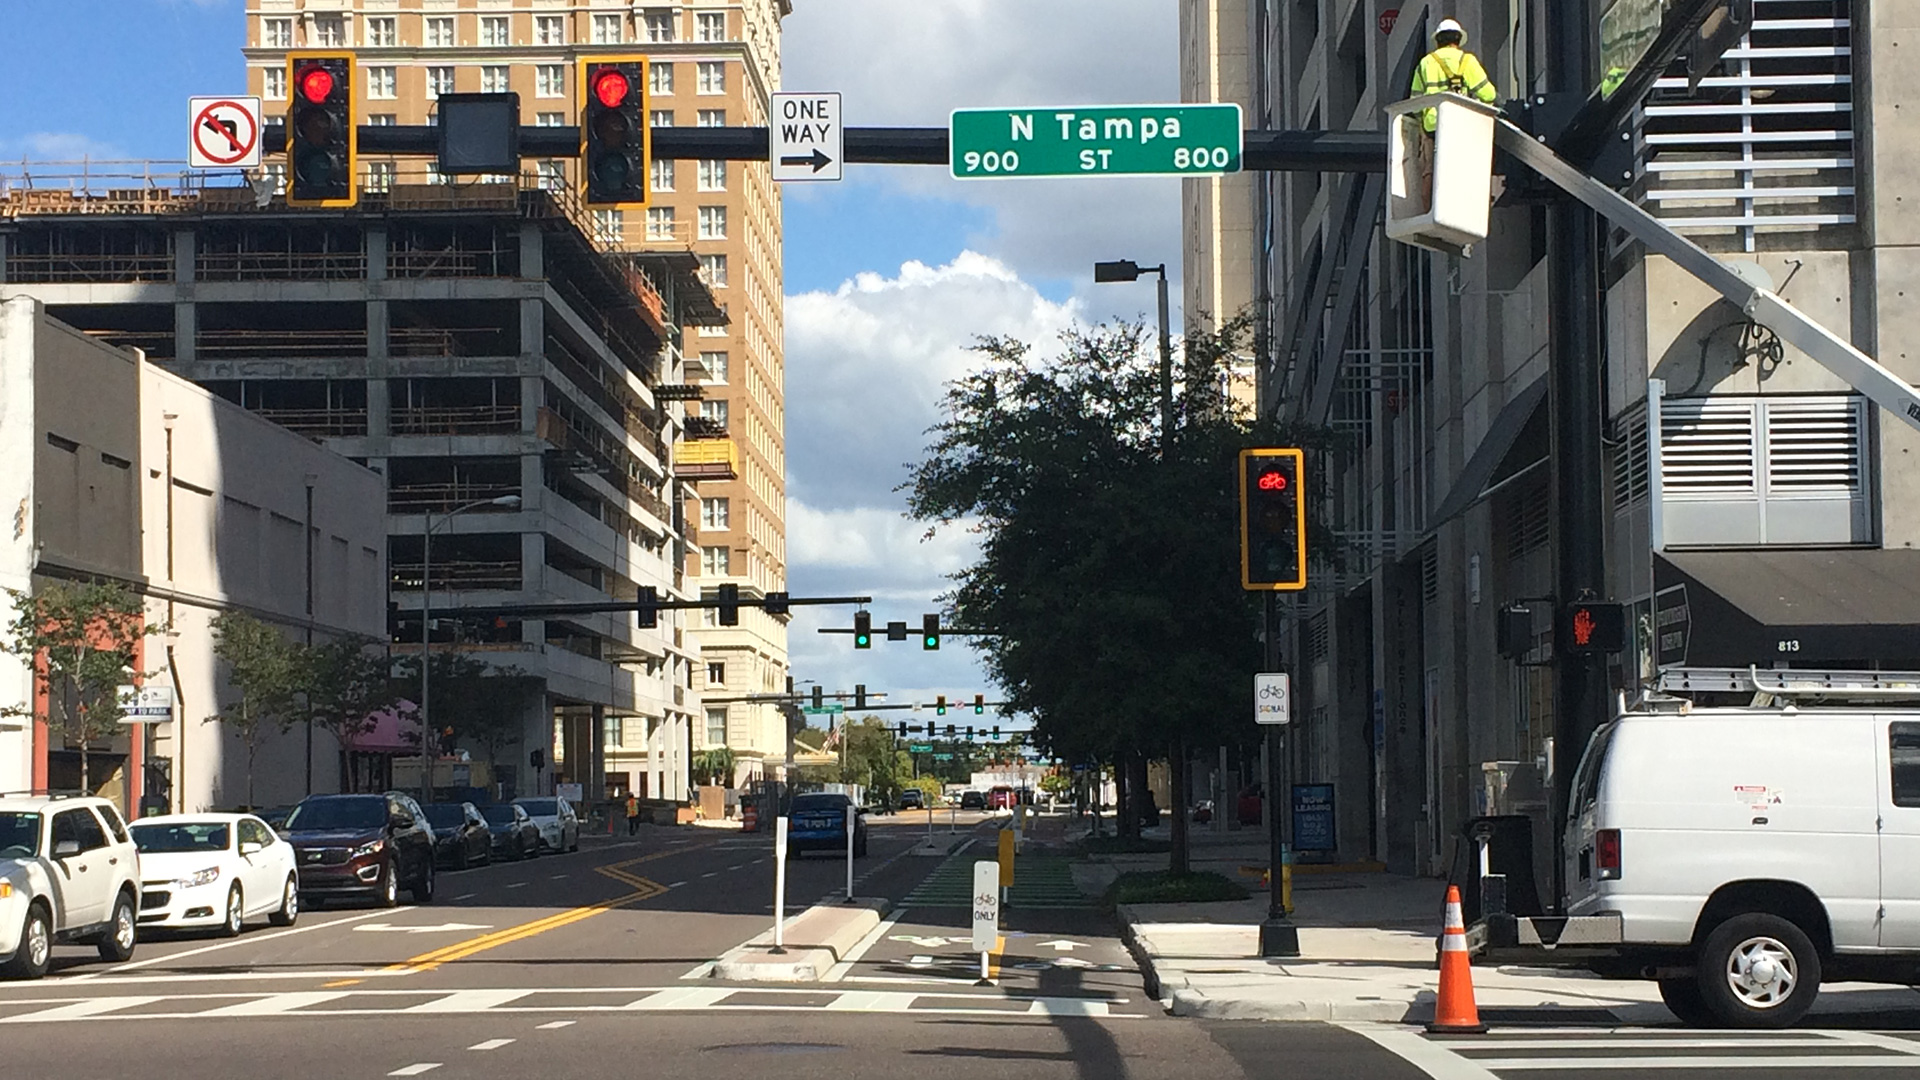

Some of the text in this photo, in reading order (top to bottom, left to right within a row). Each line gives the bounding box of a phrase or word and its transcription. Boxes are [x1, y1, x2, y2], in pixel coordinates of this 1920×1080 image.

[1380, 17, 1397, 28] STO
[783, 100, 829, 119] ONE
[781, 123, 831, 143] WAY
[1010, 112, 1181, 144] N Tampa
[963, 147, 1229, 172] 900 ST 800
[1778, 640, 1800, 651] 813
[148, 707, 168, 716] PARK
[1259, 704, 1285, 713] SIGNAL
[974, 910, 996, 921] ONLY
